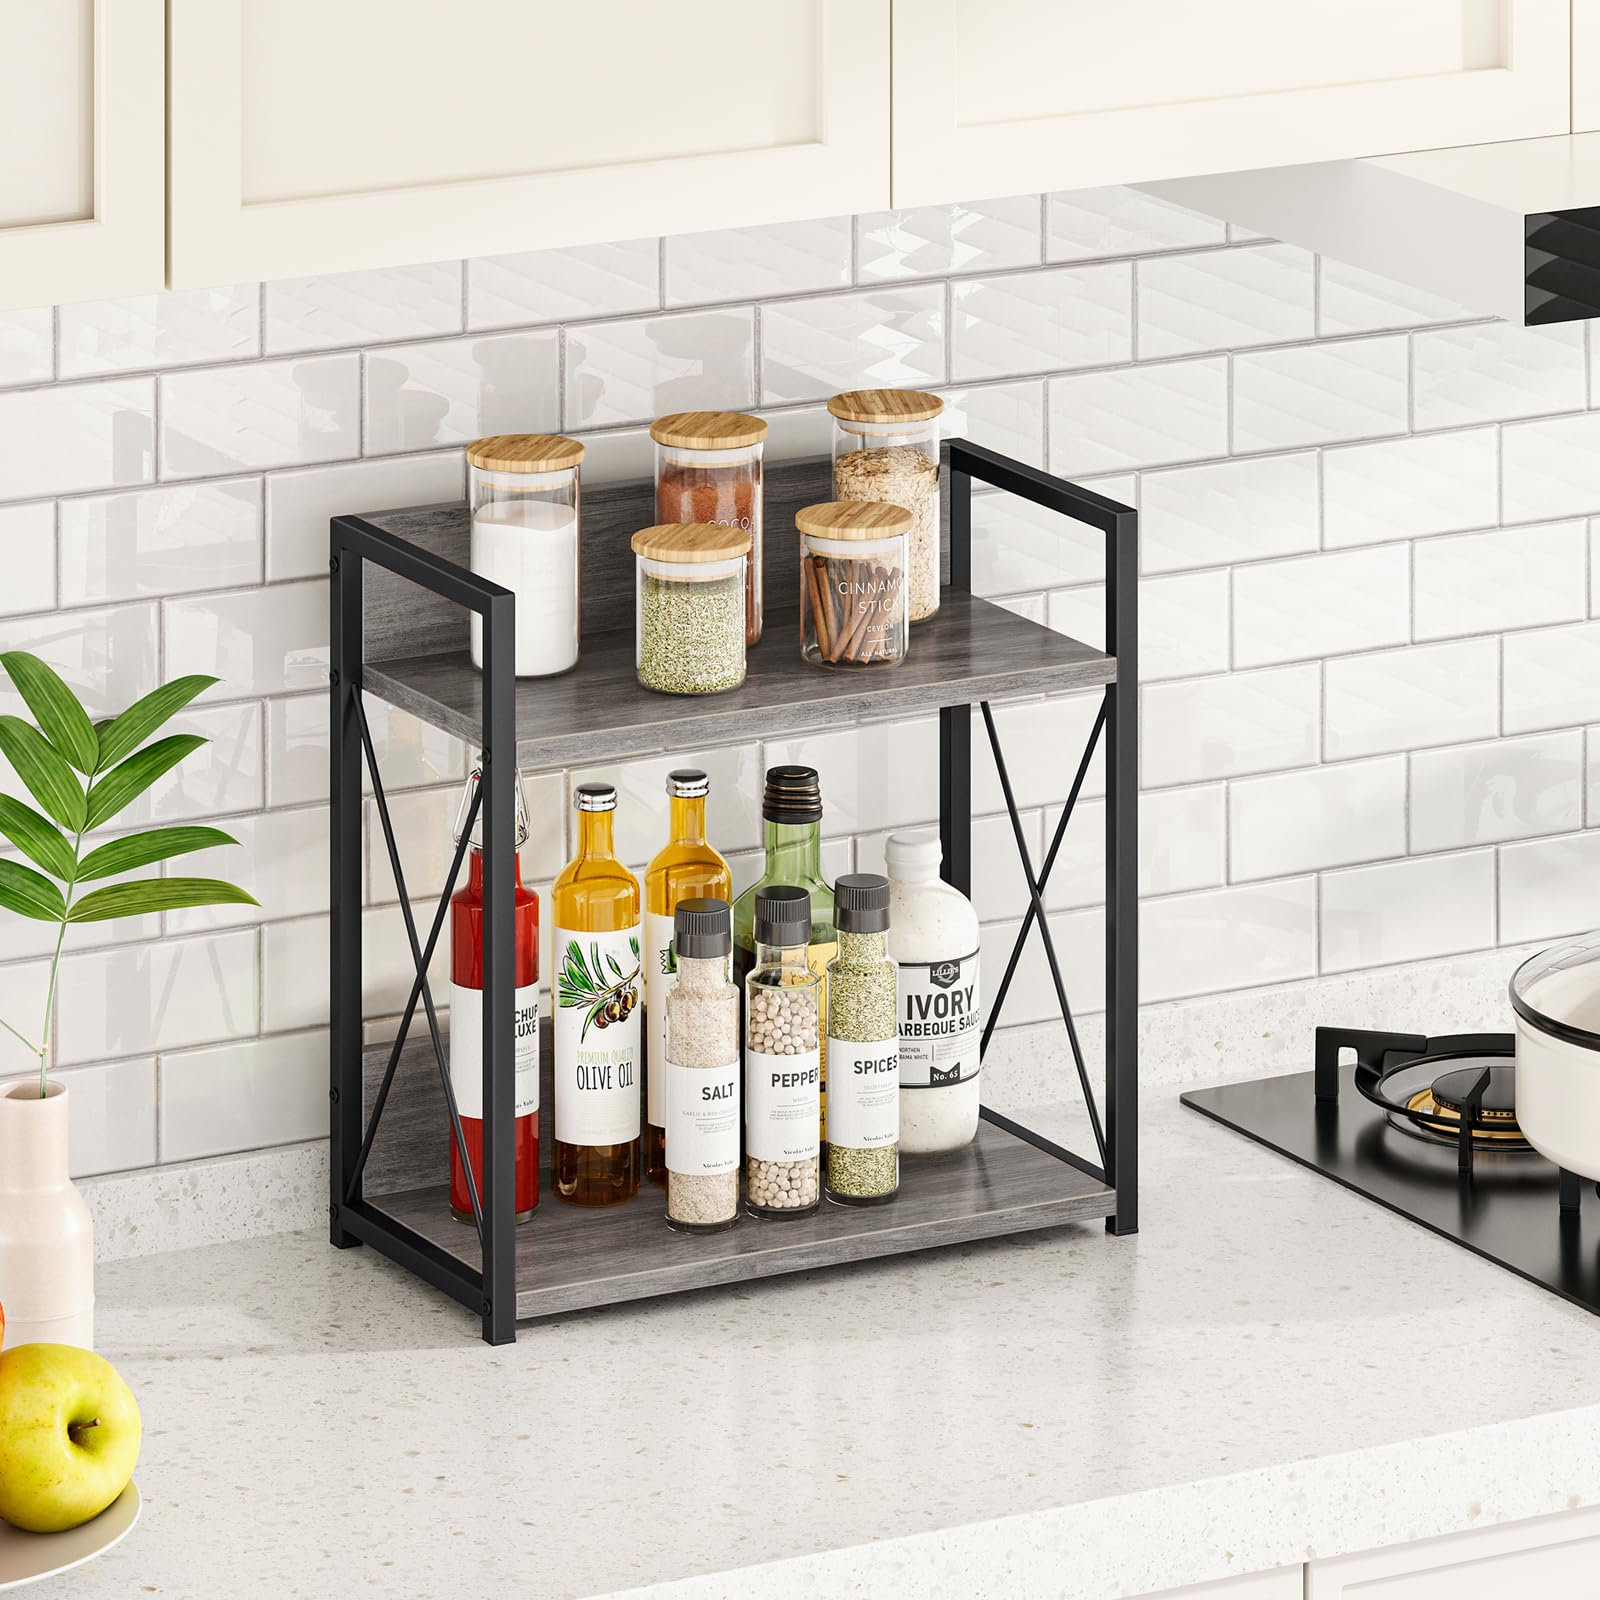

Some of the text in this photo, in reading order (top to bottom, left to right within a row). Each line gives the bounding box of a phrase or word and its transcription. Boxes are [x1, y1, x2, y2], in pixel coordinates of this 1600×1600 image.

[866, 623, 894, 633] CEYLON
[906, 984, 974, 1020] IVORY
[514, 1004, 538, 1024] CHUP
[899, 1019, 956, 1037] ARBEQUE
[853, 1054, 898, 1075] SPICES
[576, 1060, 634, 1091] OLIVE OIL
[771, 1066, 819, 1088] PEPPER
[933, 1070, 959, 1081] No. 65
[701, 1082, 735, 1101] SALT
